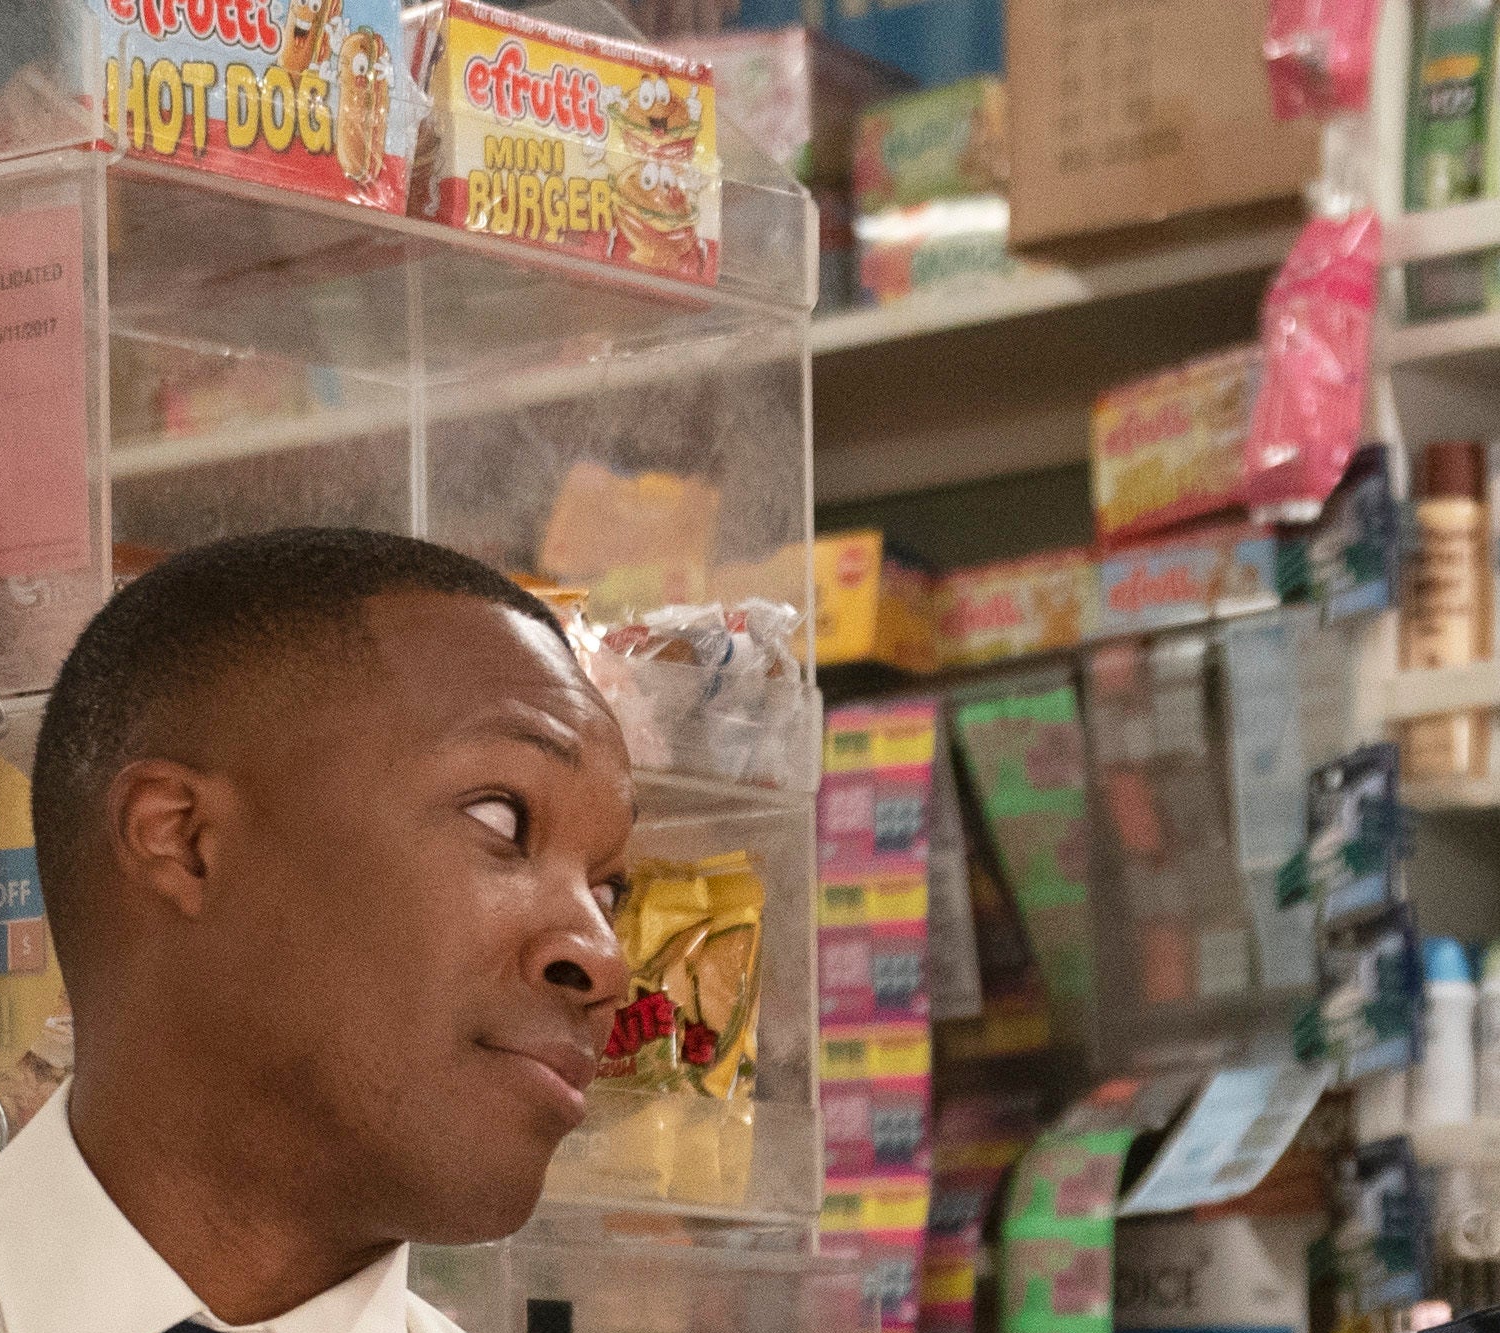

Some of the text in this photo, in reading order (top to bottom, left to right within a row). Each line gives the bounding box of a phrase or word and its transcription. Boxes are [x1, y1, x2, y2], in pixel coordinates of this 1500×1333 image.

[105, 57, 338, 155] HOT DOG
[464, 42, 608, 140] efrutti
[483, 134, 565, 175] MINI
[466, 170, 617, 244] BURGER
